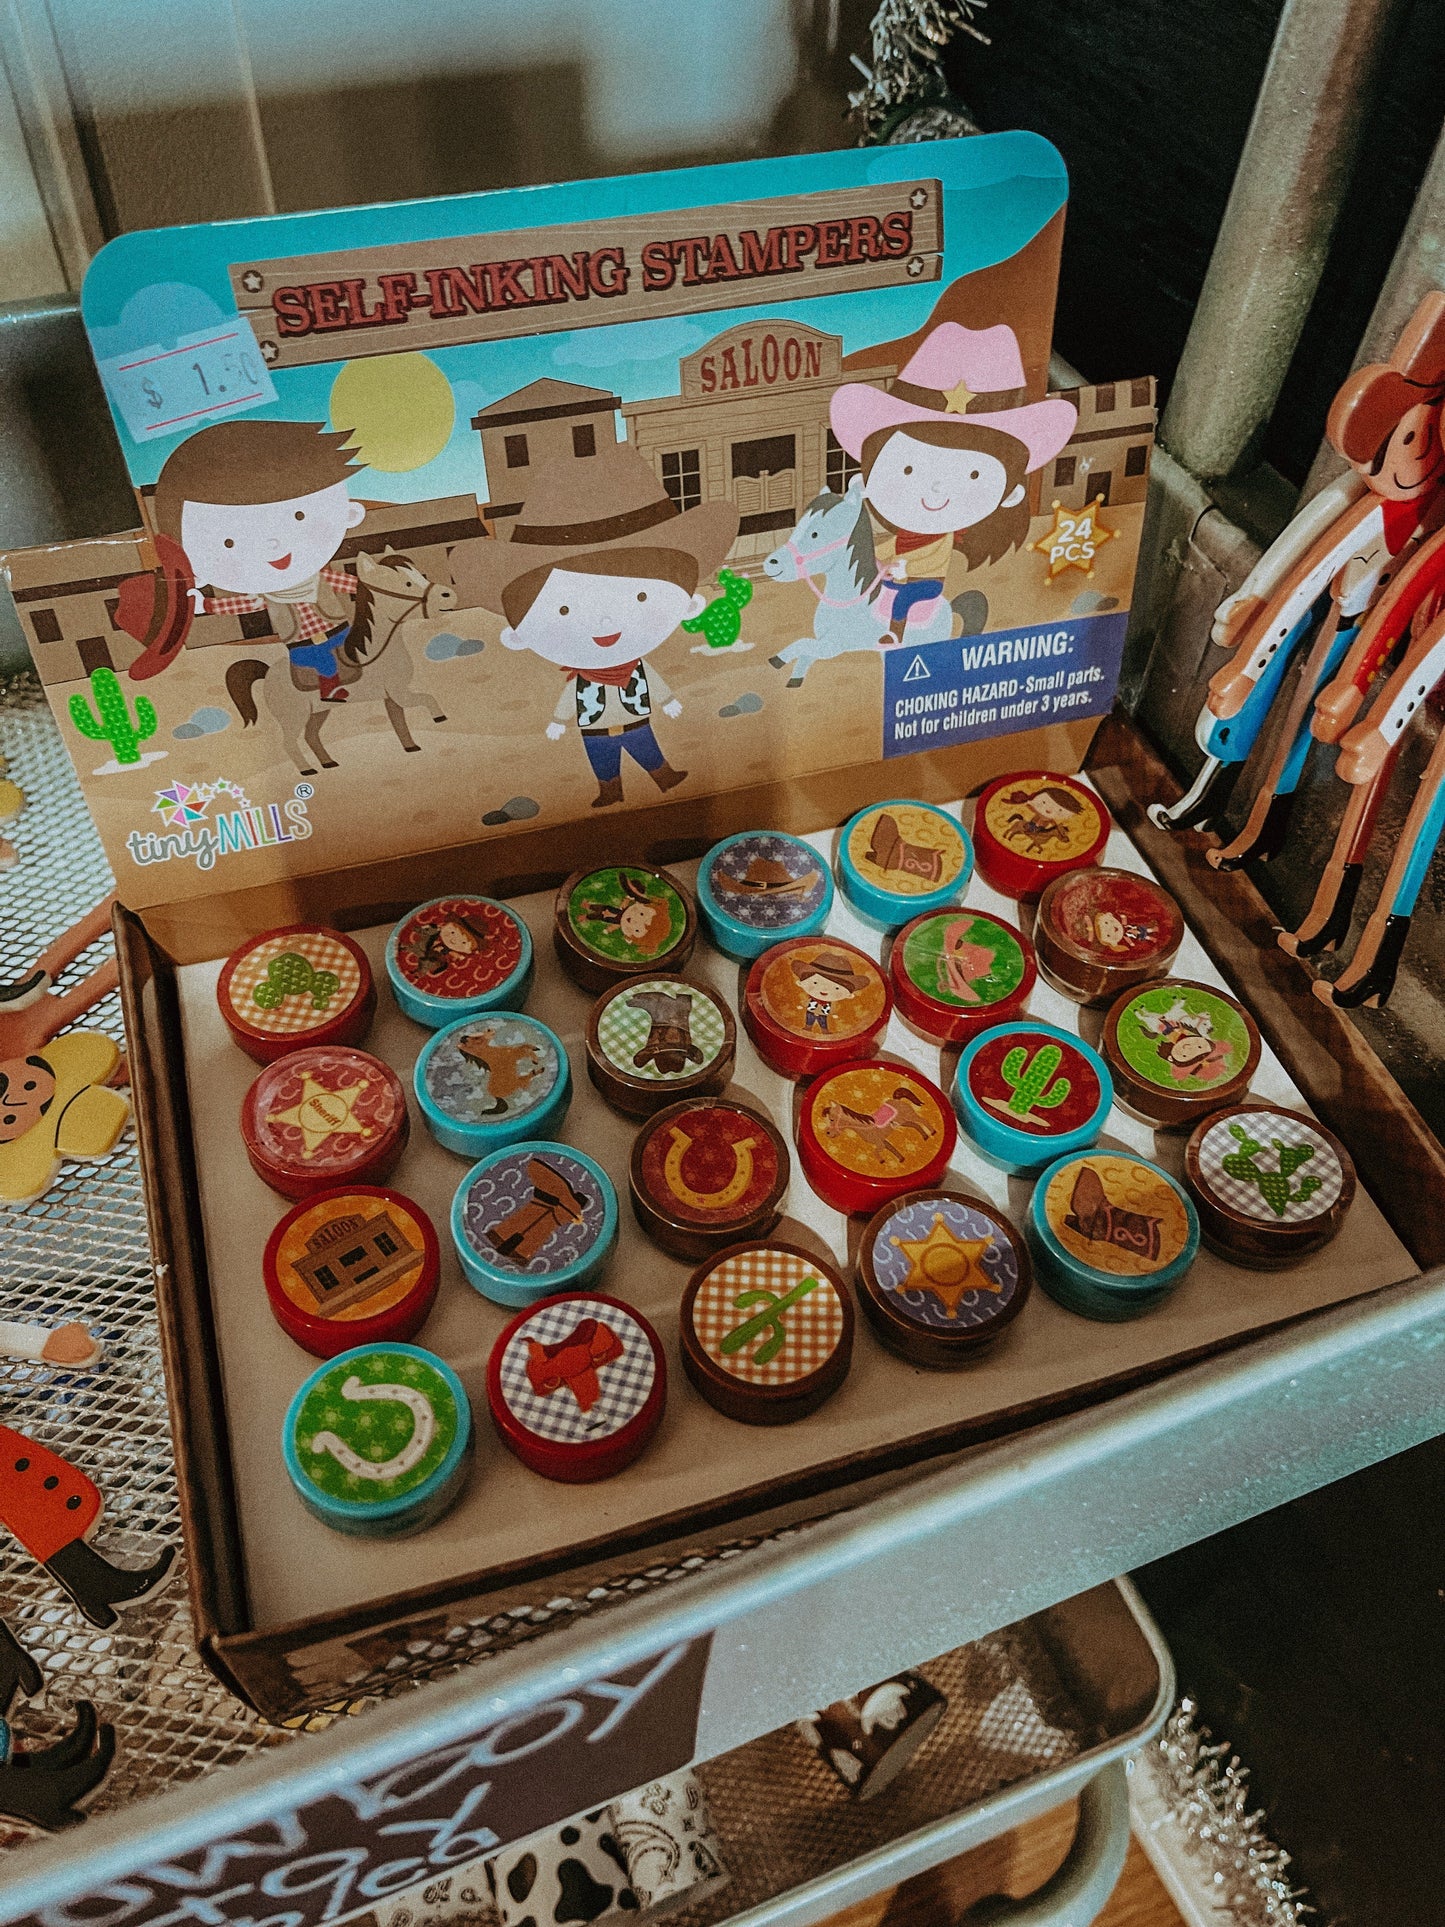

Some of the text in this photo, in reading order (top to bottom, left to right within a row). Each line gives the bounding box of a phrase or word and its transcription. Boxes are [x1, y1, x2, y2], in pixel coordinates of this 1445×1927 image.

[272, 211, 913, 338] SELF-INKING STAMPERS
[700, 333, 823, 393] SALOON
[1049, 541, 1095, 564] PCS
[1057, 517, 1093, 543] 24
[961, 631, 1075, 671] WARNING:
[895, 690, 958, 718] CHOKING
[1067, 665, 1105, 690] parts.
[894, 690, 1092, 740] Not for children under 3 years.
[309, 1098, 341, 1126] Sheriff
